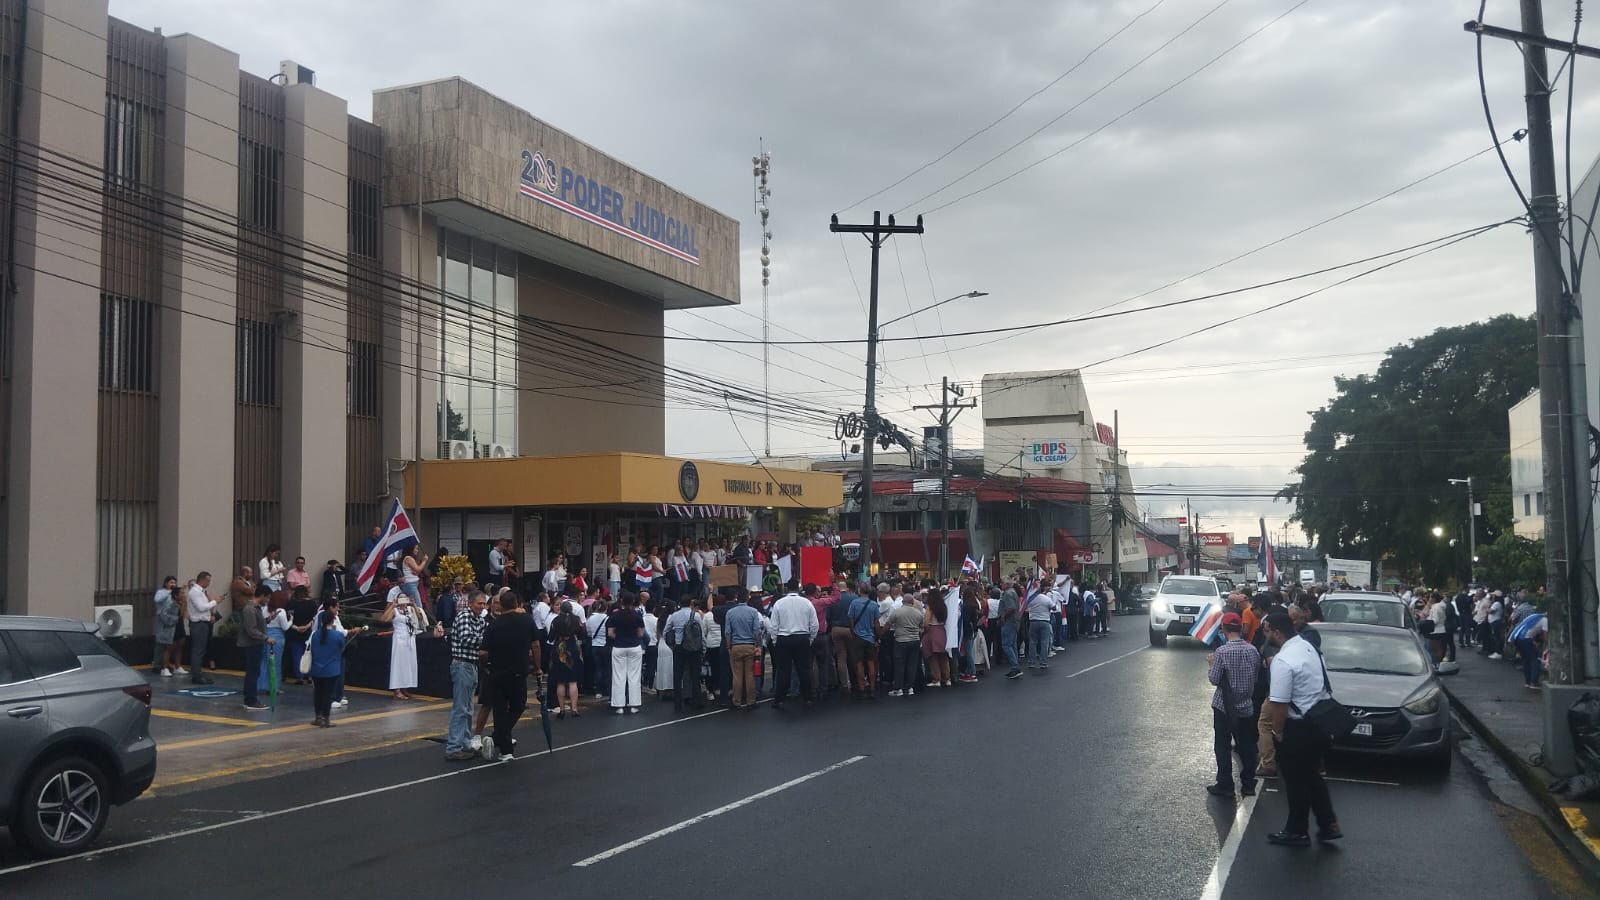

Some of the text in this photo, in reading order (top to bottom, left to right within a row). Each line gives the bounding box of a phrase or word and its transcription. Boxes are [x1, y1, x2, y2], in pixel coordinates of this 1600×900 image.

[561, 167, 624, 226] PODER
[629, 200, 699, 257] JUDICIAL
[1032, 442, 1067, 455] POPS
[1034, 455, 1043, 463] ICE
